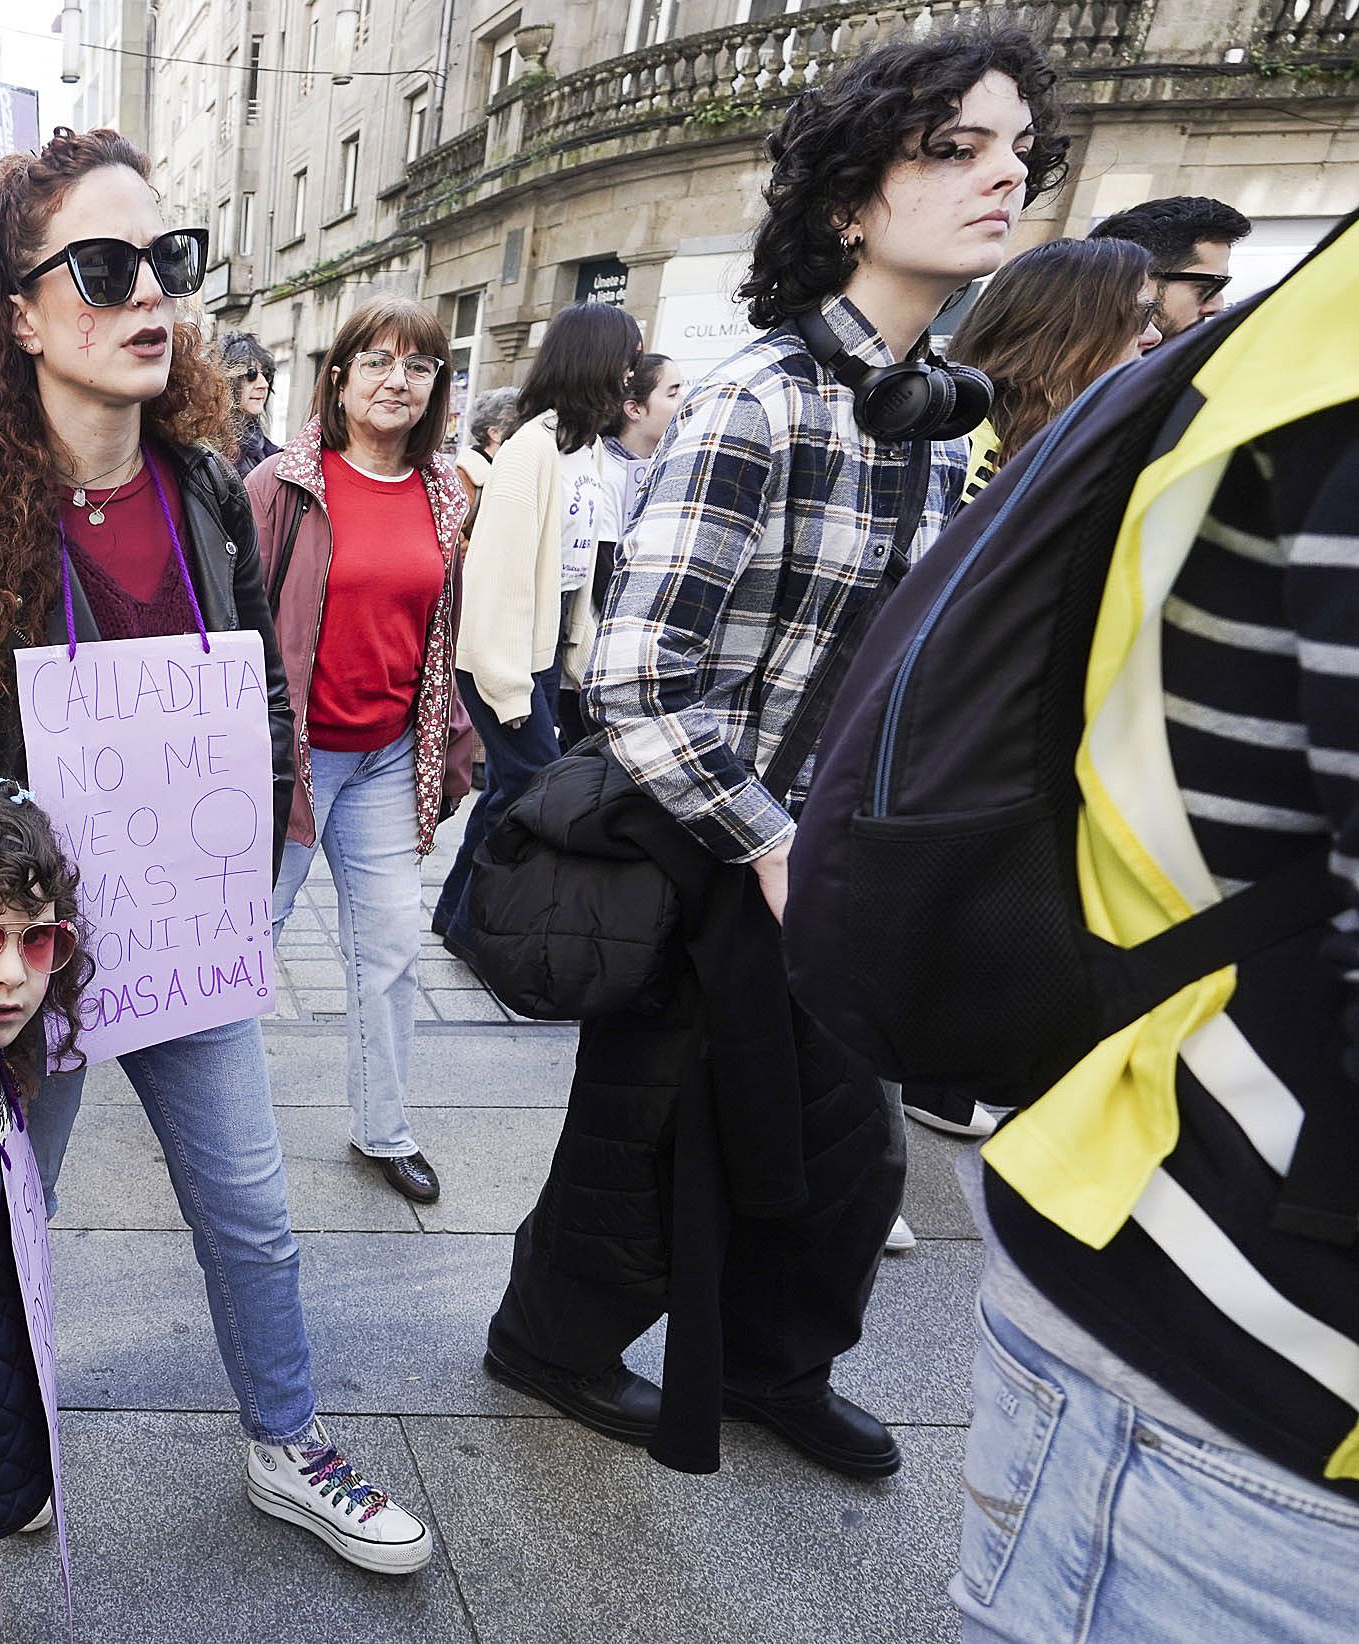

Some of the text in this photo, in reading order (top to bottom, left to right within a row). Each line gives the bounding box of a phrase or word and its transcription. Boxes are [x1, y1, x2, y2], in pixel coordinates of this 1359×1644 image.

[683, 322, 751, 338] CULMIA
[32, 659, 267, 734] CALLADITA
[57, 734, 231, 799] NO ME
[65, 806, 159, 862] VEO
[81, 864, 178, 918] MAS
[197, 950, 269, 997] UNA!
